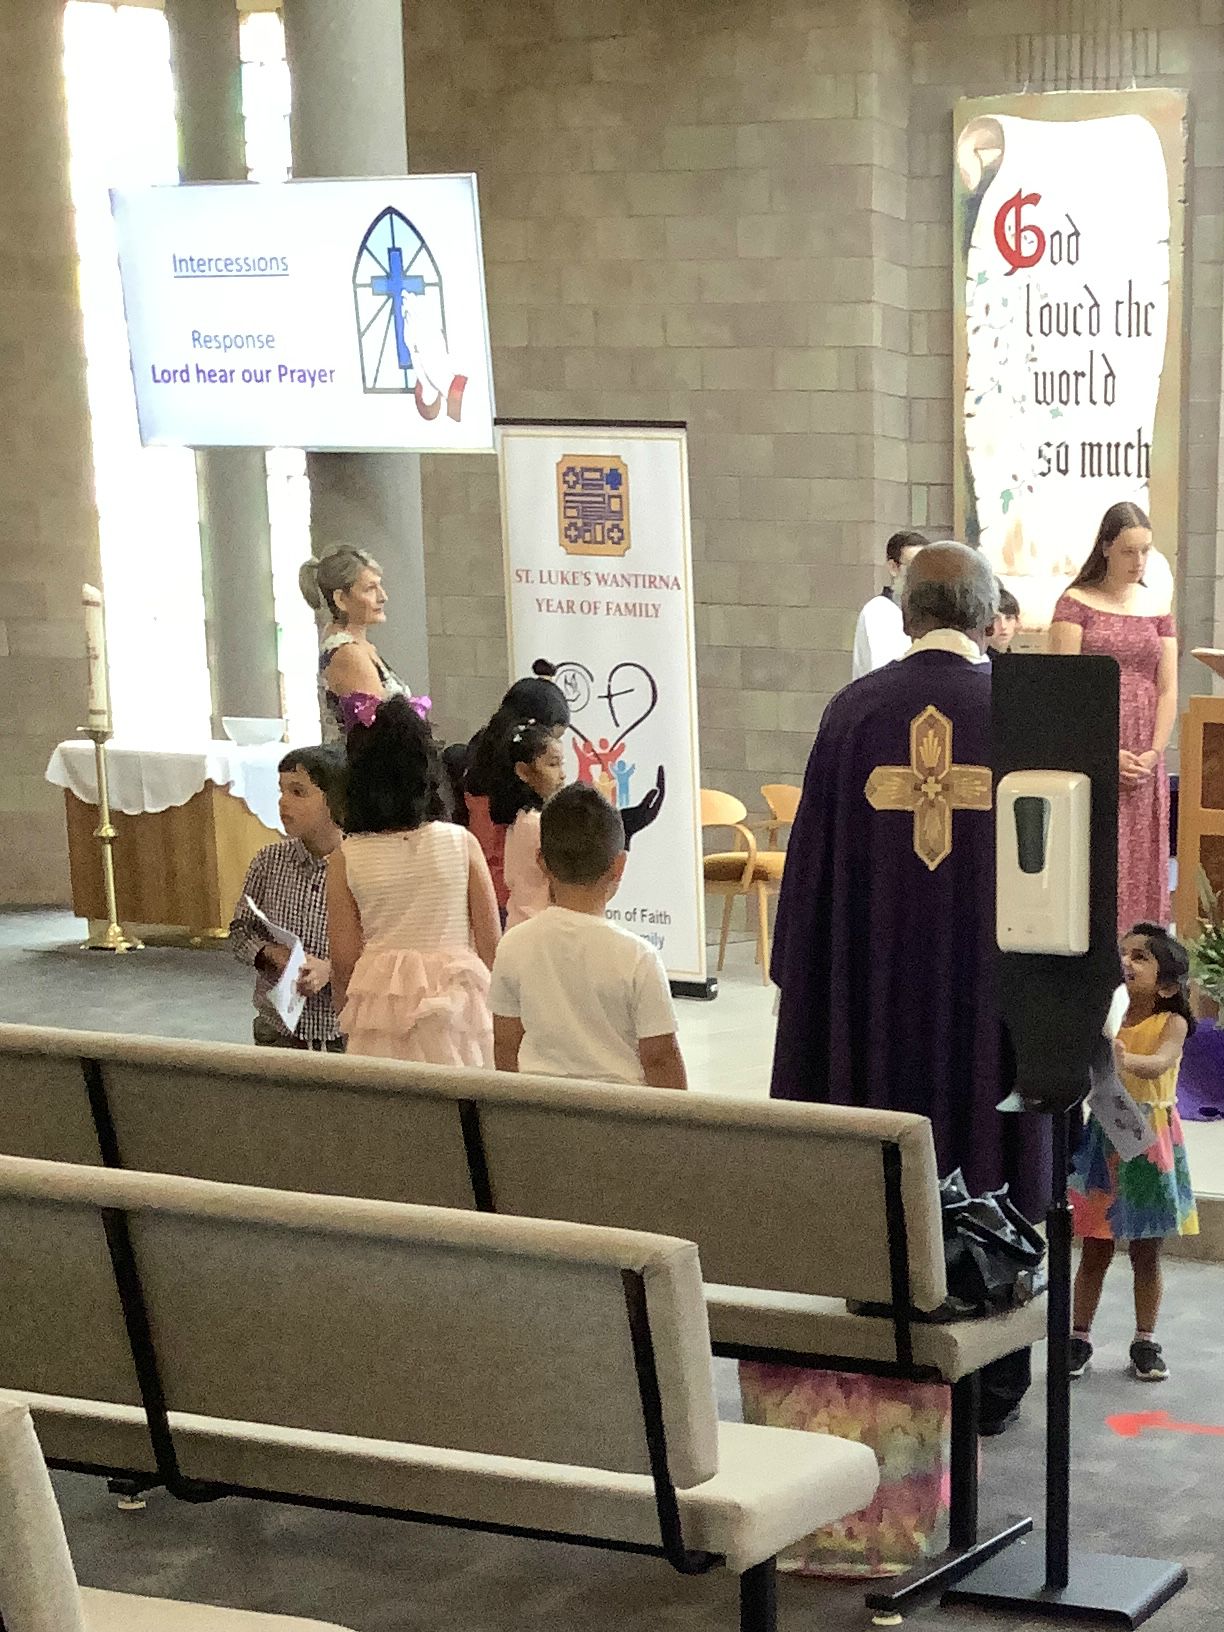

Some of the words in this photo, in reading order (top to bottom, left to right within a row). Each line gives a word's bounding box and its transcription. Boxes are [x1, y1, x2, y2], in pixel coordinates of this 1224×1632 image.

[994, 188, 1081, 276] God
[173, 253, 289, 273] Intercessions
[1026, 282, 1100, 337] loved
[1115, 279, 1155, 338] the
[192, 329, 275, 353] Response
[151, 363, 190, 384] Lord
[195, 362, 235, 384] hear
[241, 368, 272, 384] our
[277, 364, 335, 389] Prayer
[1033, 349, 1117, 407] world
[1037, 440, 1070, 478] so
[1080, 425, 1151, 479] much
[515, 569, 535, 585] ST.
[539, 569, 592, 587] LUKE'S
[594, 571, 682, 591] WANTIRNA
[535, 597, 577, 615] YEAR
[580, 599, 601, 616] OF
[605, 601, 662, 619] FAMILY
[624, 906, 638, 923] of
[639, 907, 672, 926] Faith
